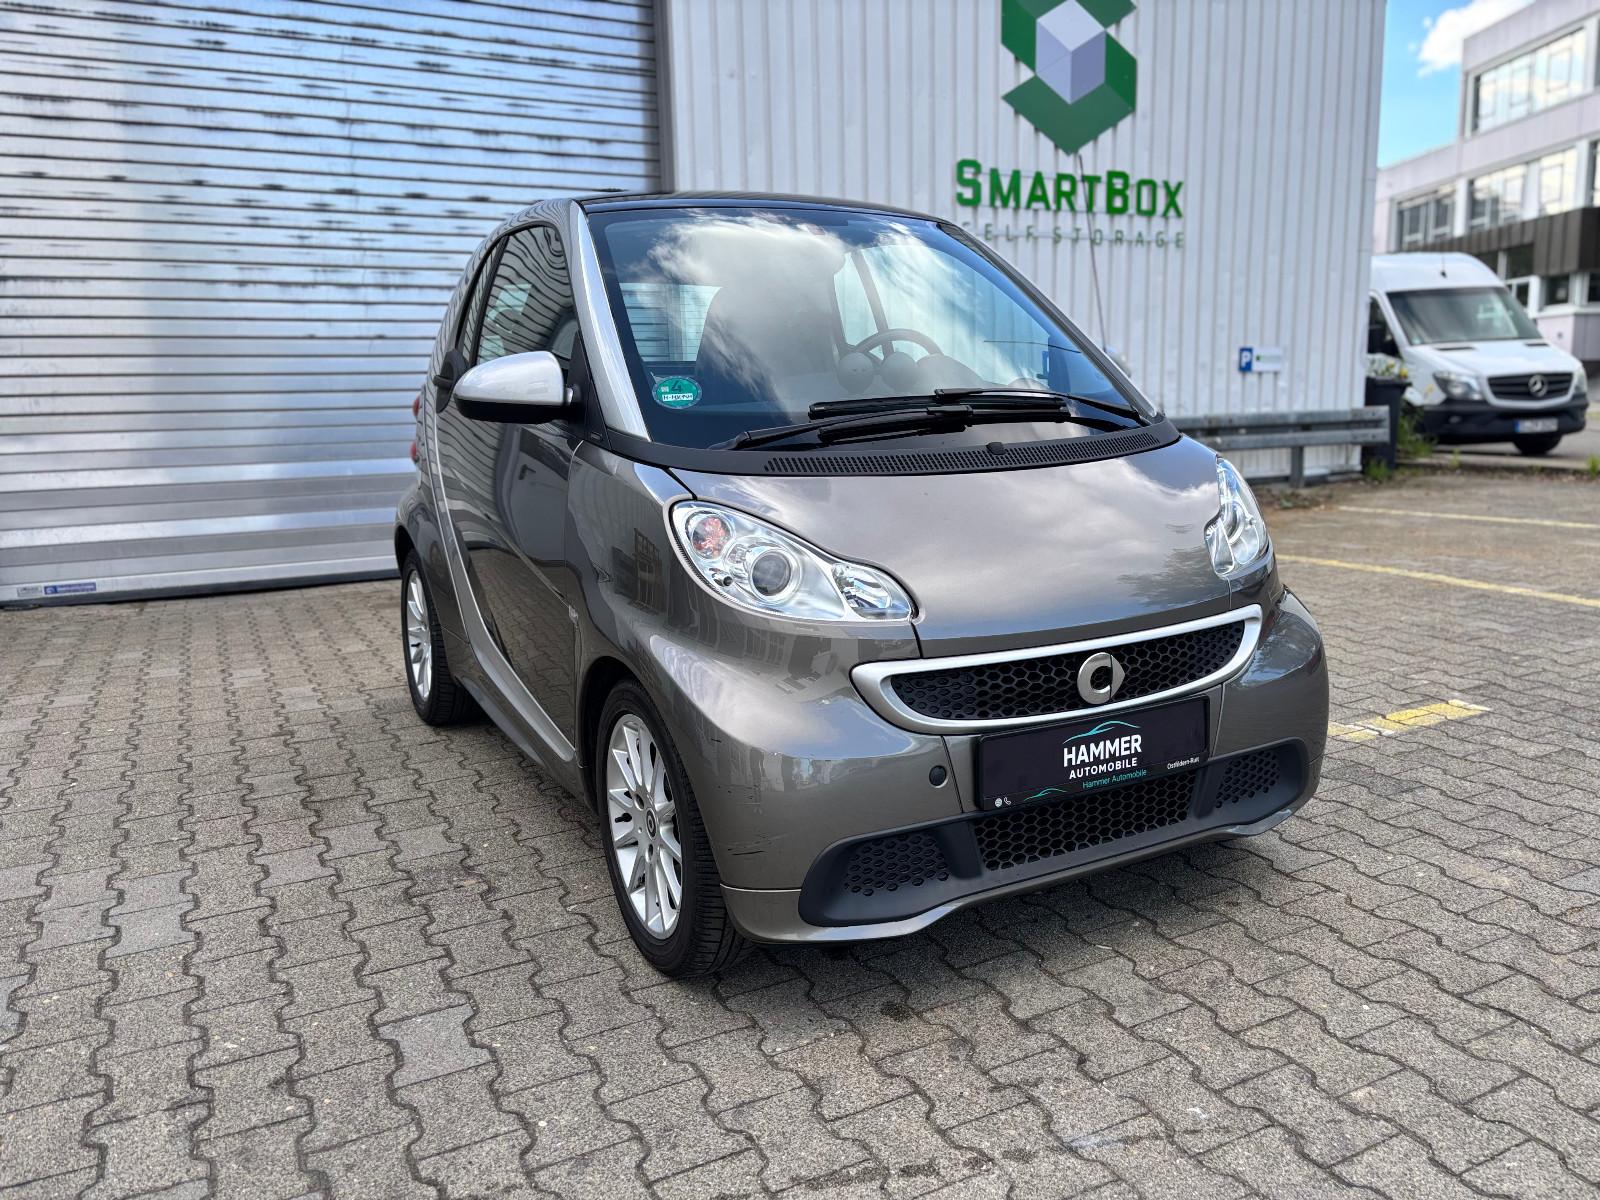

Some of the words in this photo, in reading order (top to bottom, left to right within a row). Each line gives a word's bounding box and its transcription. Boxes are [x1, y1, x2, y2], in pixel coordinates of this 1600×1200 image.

[1053, 226, 1184, 248] STORAGE
[671, 380, 682, 392] 4
[1064, 734, 1142, 768] HAMMER
[1069, 757, 1138, 779] AUTOMOBILE
[1082, 777, 1111, 789] Hammer
[1112, 769, 1147, 783] Automobile
